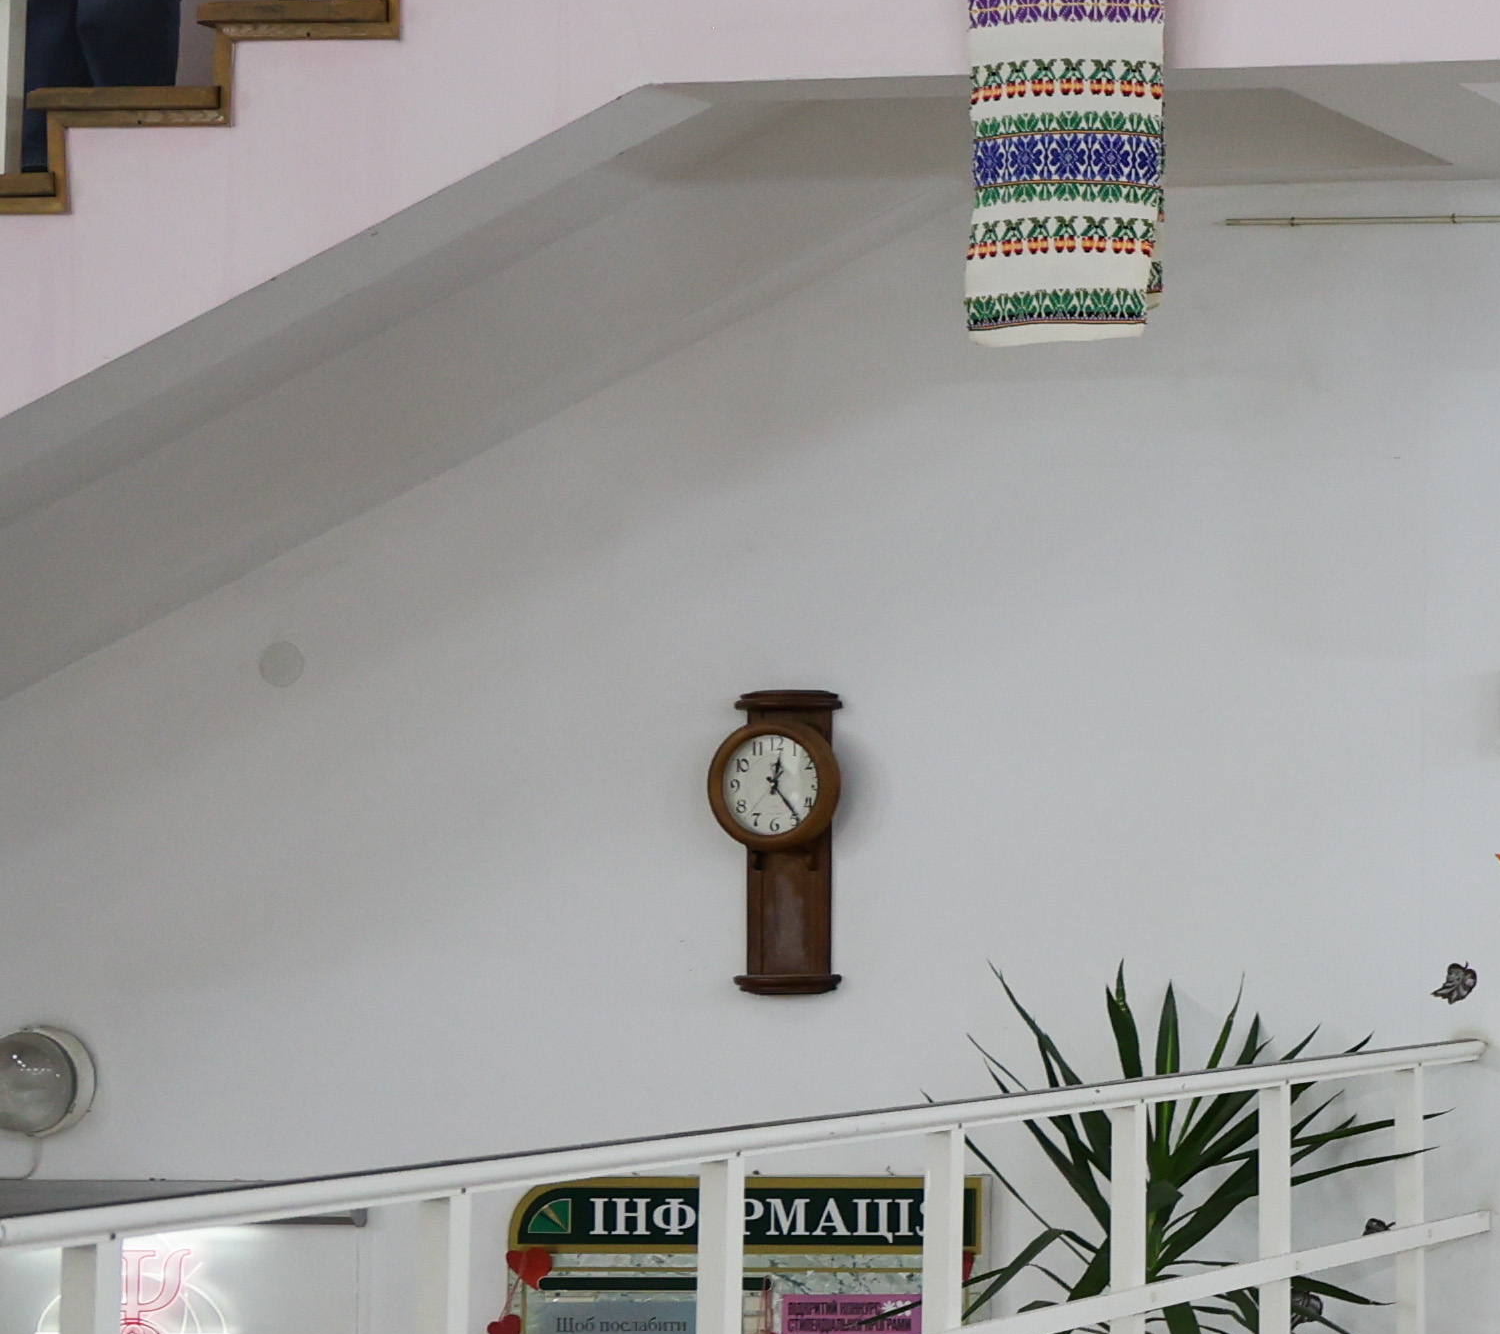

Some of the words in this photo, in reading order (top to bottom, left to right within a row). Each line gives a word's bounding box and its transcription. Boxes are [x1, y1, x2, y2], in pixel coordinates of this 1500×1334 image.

[736, 758, 750, 773] 10
[736, 799, 747, 813] 8
[751, 812, 761, 827] 7
[769, 816, 780, 832] 6
[590, 1197, 925, 1244] ІНФРМАЦІ
[555, 1317, 595, 1333] Щоб
[599, 1316, 687, 1332] послабити
